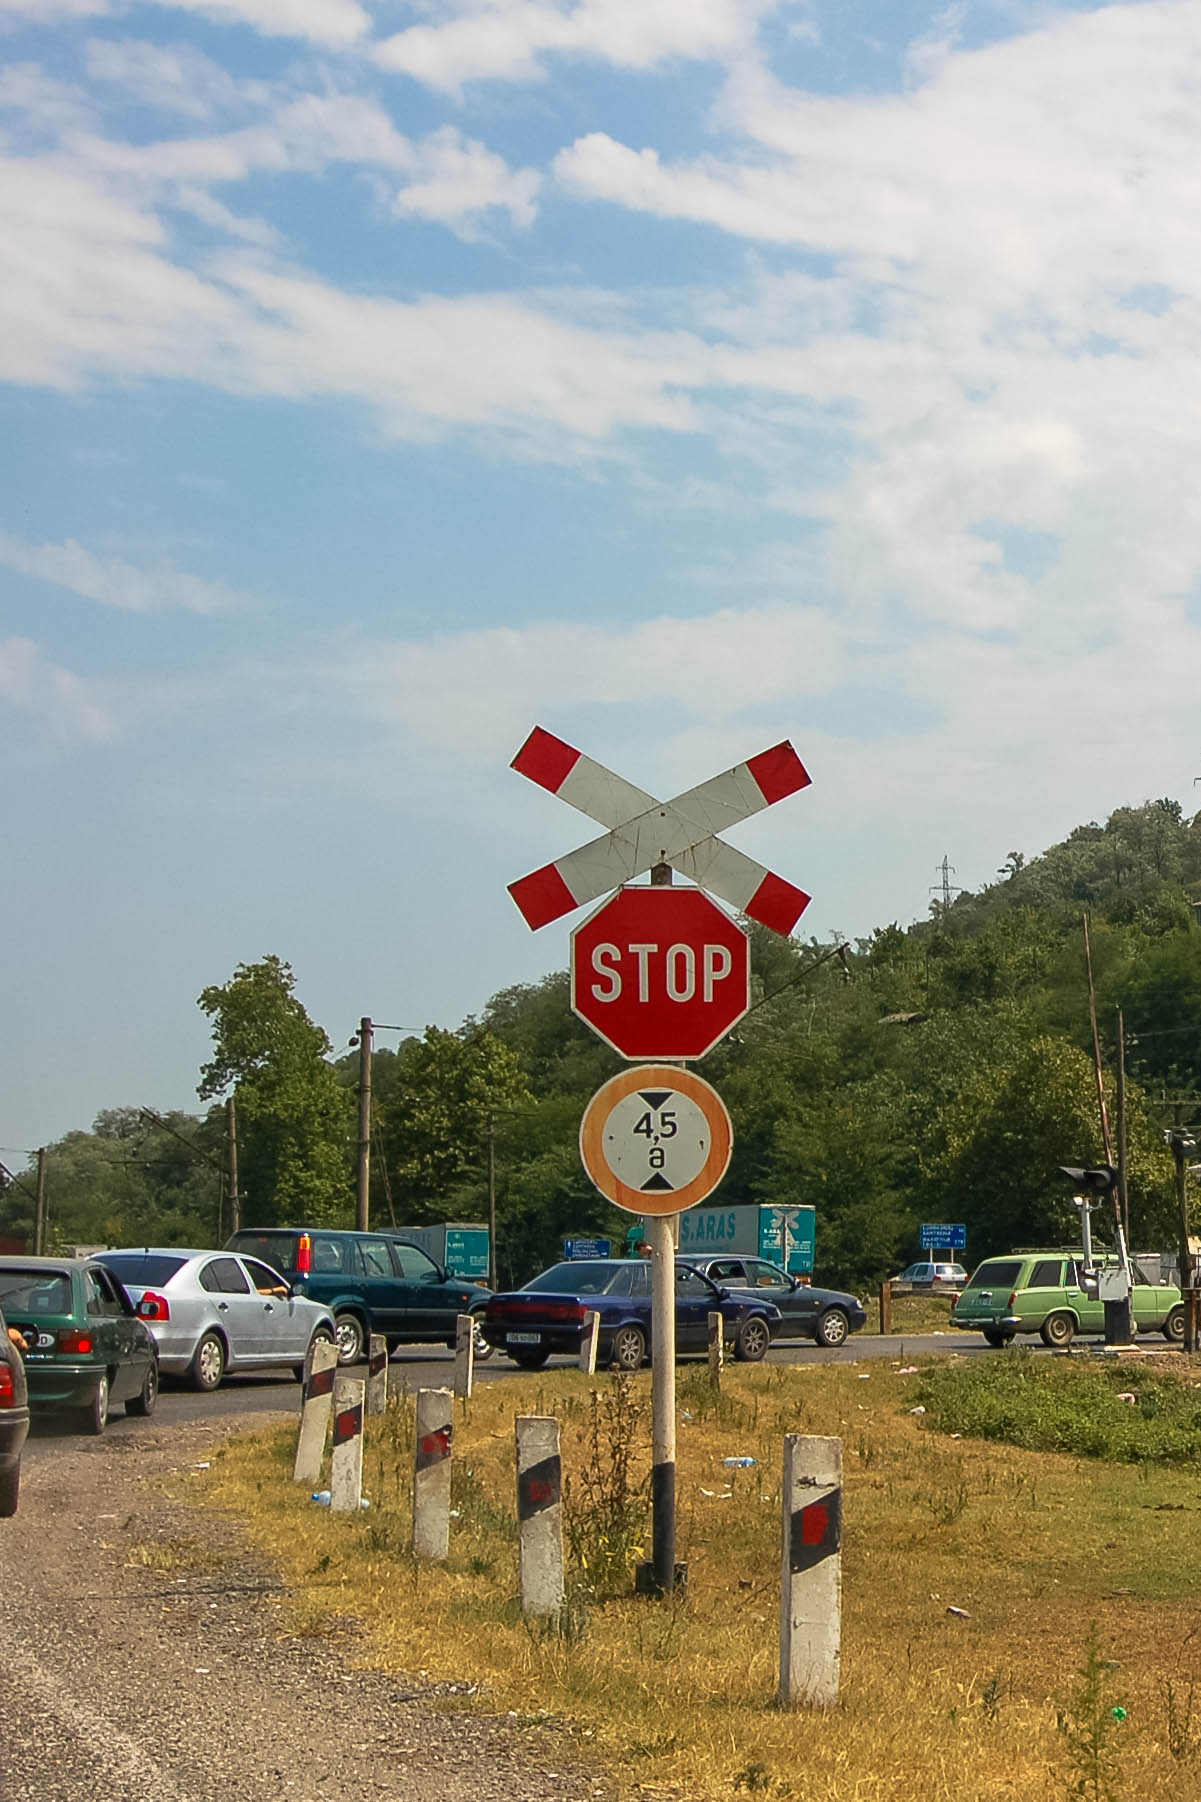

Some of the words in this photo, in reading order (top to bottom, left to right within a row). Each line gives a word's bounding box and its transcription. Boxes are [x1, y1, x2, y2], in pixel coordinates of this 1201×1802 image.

[590, 942, 734, 1004] STOP
[633, 1111, 678, 1146] 4,5
[681, 1212, 737, 1241] S.ARAS
